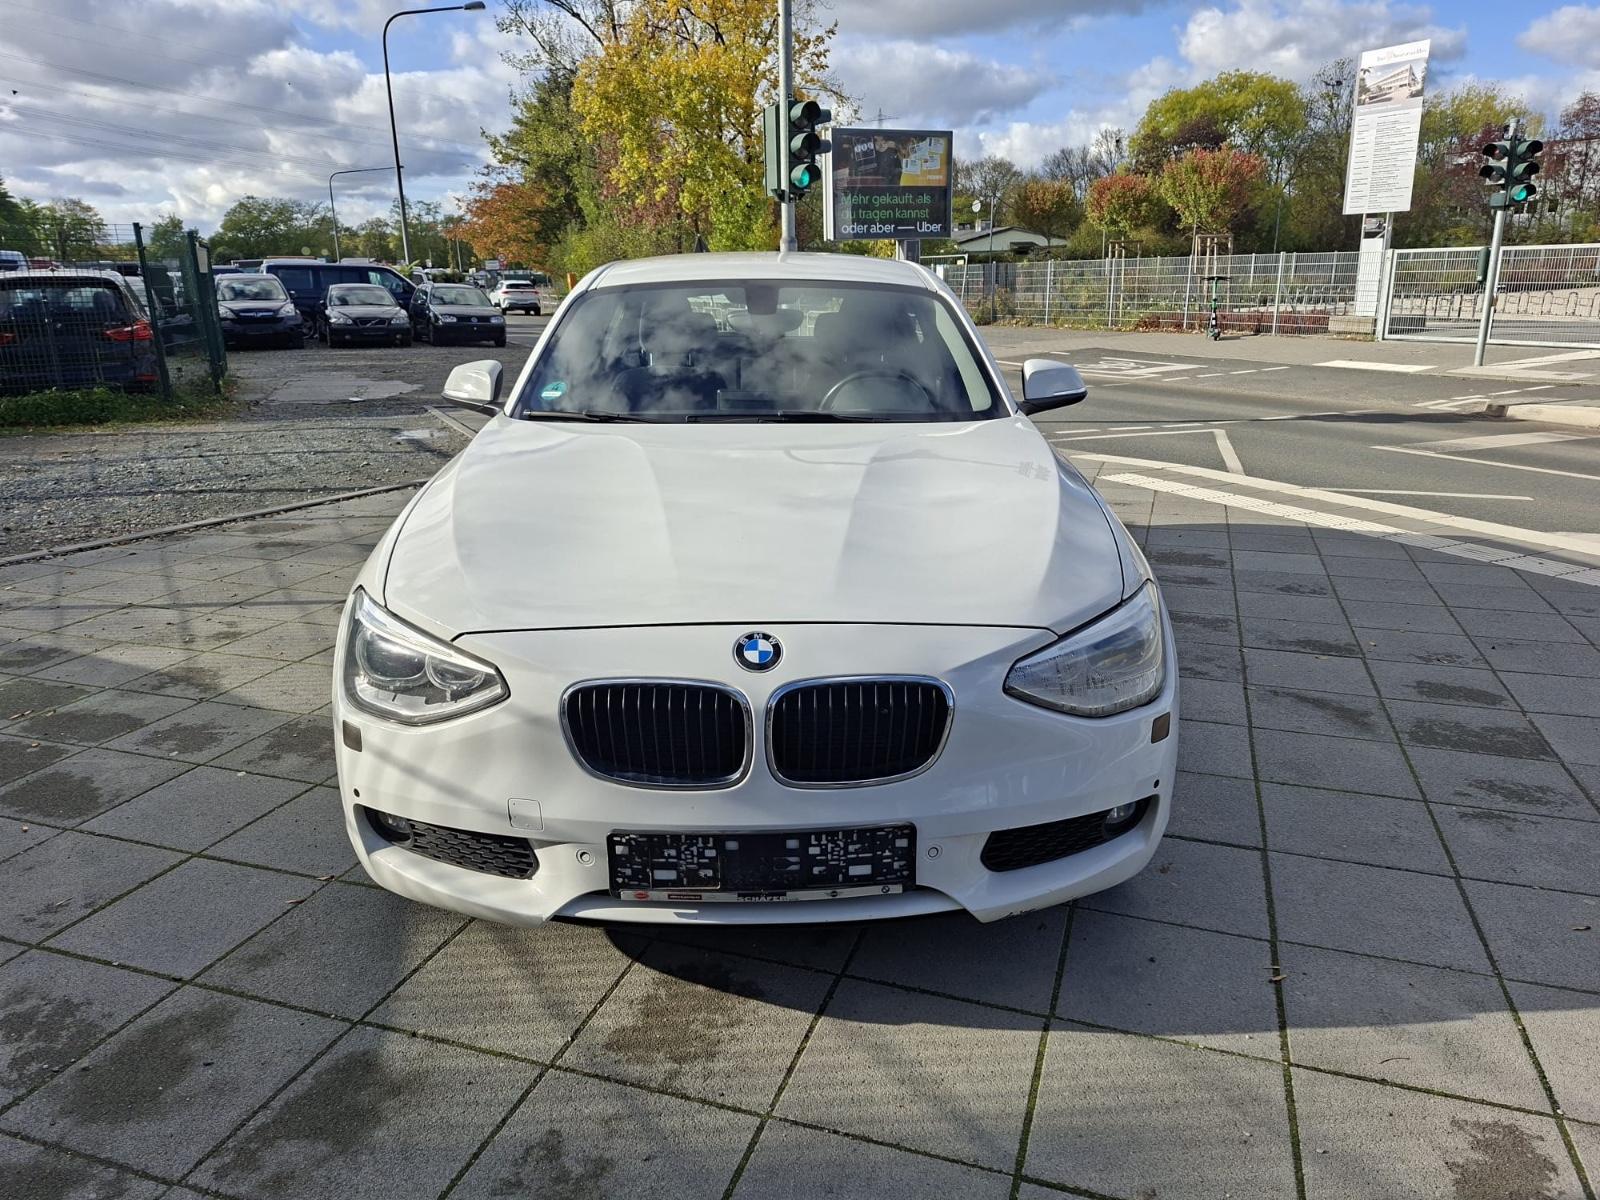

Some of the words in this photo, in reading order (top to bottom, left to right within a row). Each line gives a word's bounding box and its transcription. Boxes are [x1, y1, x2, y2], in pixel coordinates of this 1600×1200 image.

[841, 193, 869, 204] Mehr
[872, 193, 915, 206] gekauft,
[917, 193, 931, 204] als
[841, 208, 856, 219] du
[859, 208, 893, 221] tragen
[895, 208, 929, 219] kannst
[841, 222, 868, 233] oder
[870, 222, 895, 233] aber
[917, 221, 942, 232] Uber
[739, 633, 778, 645] BMW
